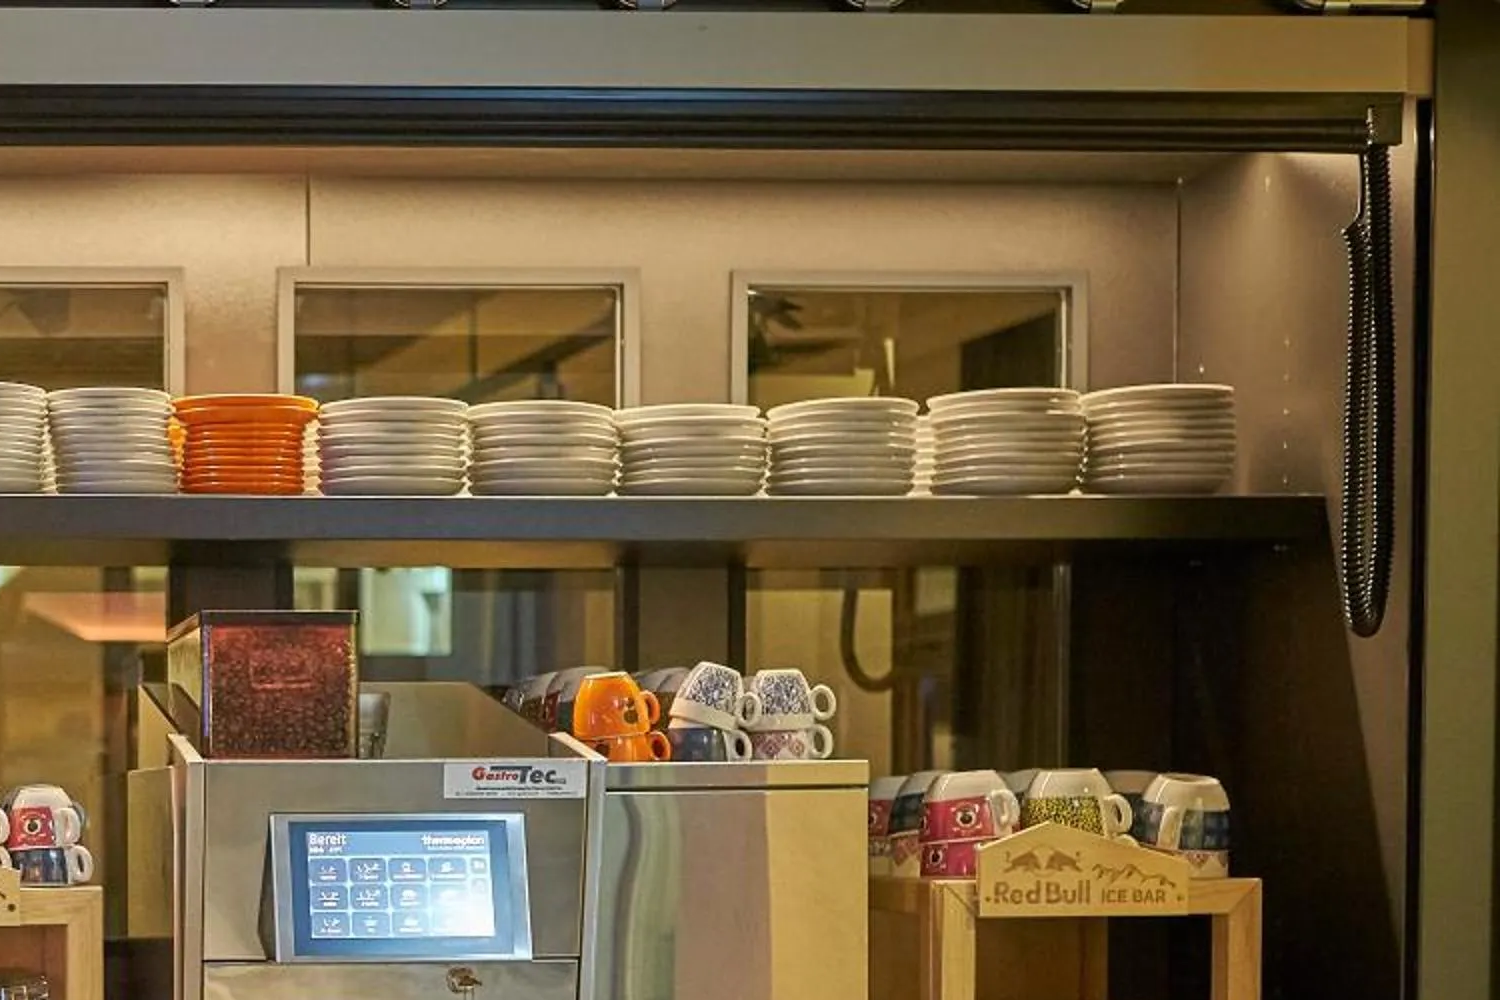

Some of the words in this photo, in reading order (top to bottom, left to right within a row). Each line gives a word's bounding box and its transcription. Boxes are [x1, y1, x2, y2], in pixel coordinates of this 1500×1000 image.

[309, 834, 347, 845] Bereit
[993, 880, 1041, 904] Red
[1045, 880, 1091, 905] Bull
[1101, 888, 1128, 903] ICE
[1132, 888, 1166, 904] BAR
